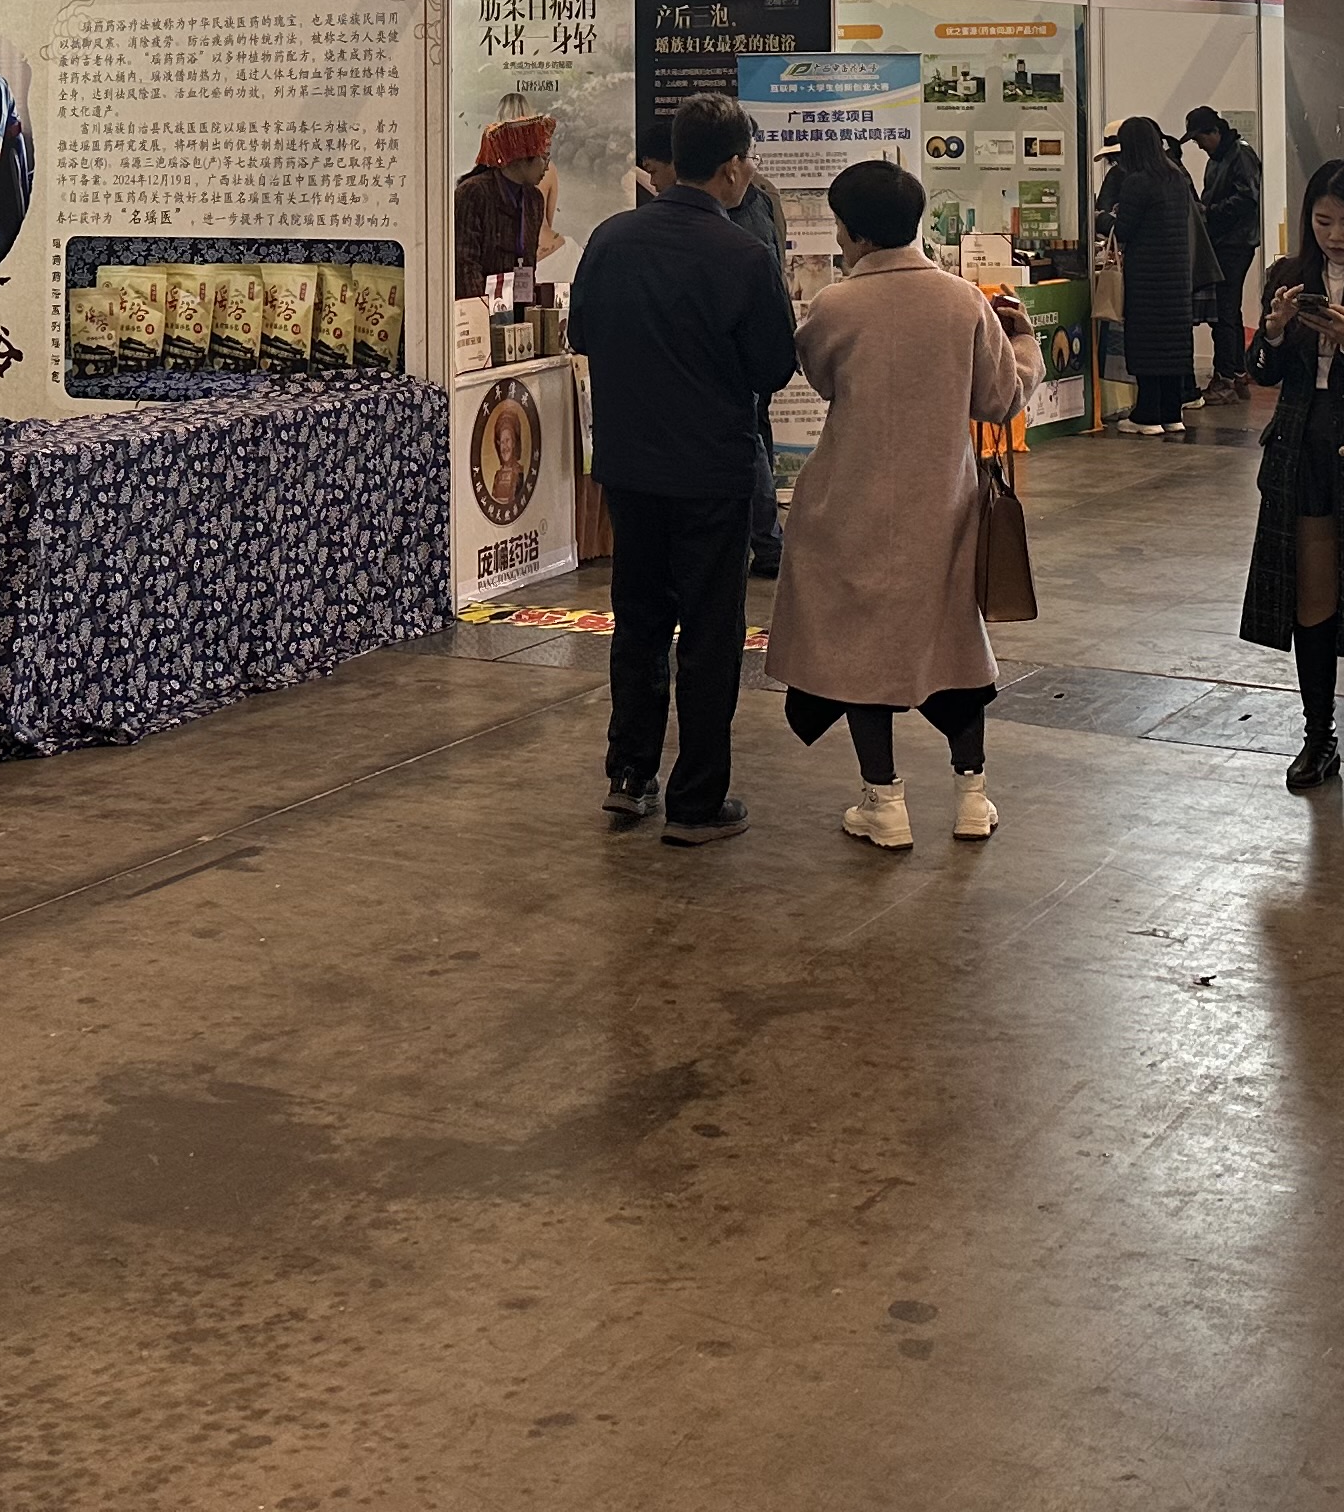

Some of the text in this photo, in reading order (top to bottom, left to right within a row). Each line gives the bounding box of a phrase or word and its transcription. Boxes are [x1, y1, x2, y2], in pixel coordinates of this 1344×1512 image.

[478, 22, 598, 56] 不堵一身轻
[654, 34, 797, 54] 瑶族妇女最爱的泡浴
[787, 110, 875, 124] 广西金奖项目
